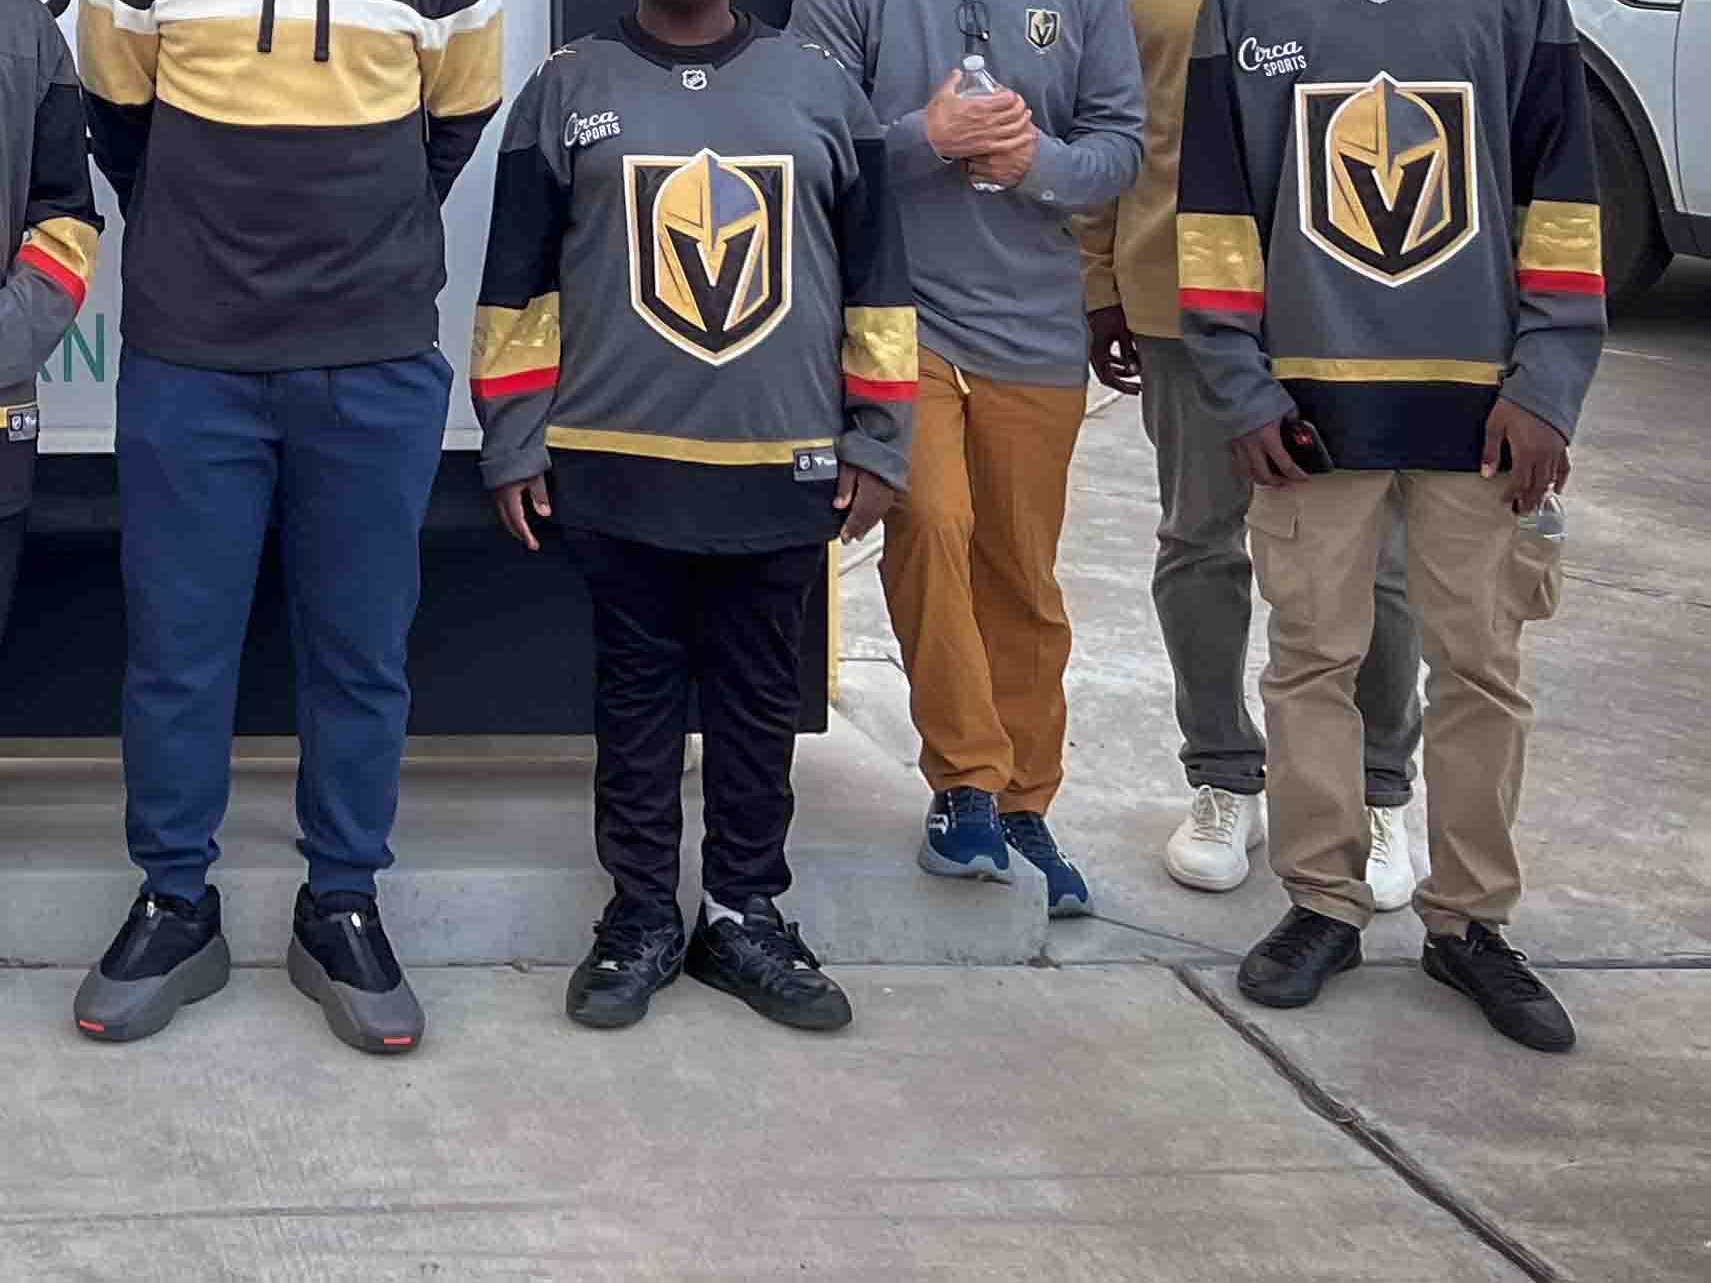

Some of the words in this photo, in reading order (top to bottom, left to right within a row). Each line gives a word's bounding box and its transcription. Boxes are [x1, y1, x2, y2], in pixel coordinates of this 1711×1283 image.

[1239, 36, 1304, 71] Circa
[1263, 54, 1307, 77] SPORTS
[579, 122, 621, 146] SPORTS
